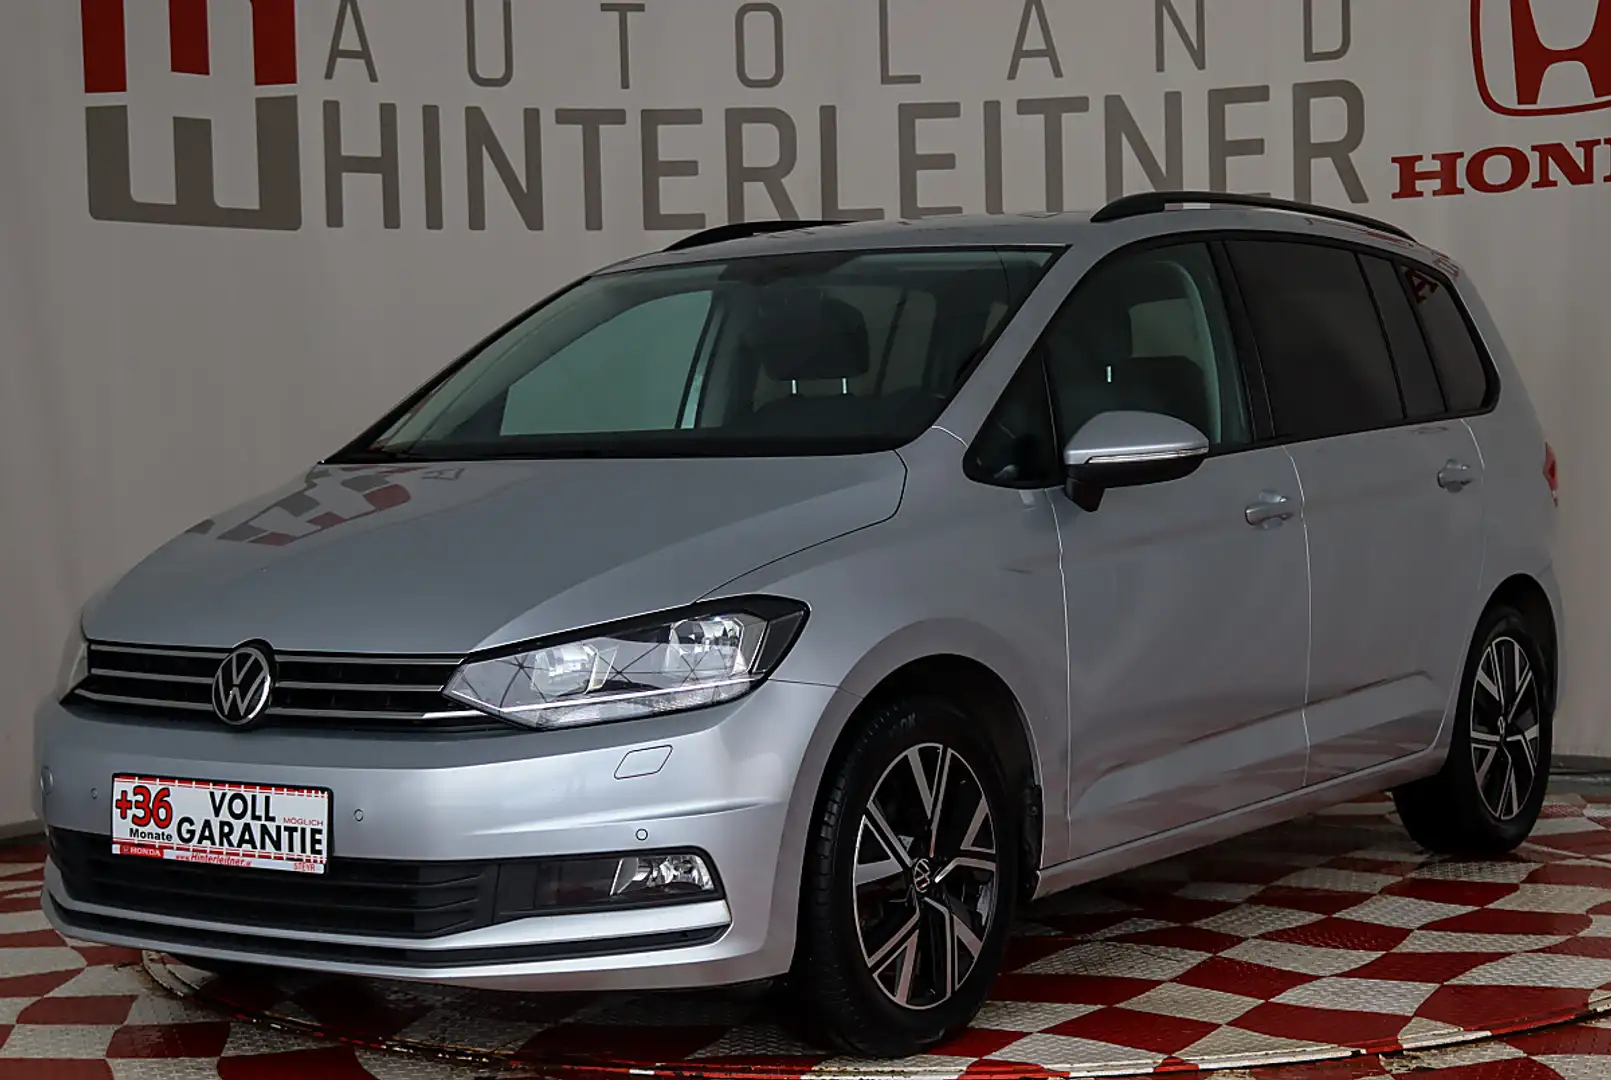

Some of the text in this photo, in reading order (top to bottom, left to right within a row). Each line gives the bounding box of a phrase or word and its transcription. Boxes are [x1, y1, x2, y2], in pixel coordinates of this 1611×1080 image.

[323, 79, 1370, 231] HINTERLEITNER
[115, 785, 173, 829] +36
[209, 791, 276, 822] VOLL
[129, 828, 173, 842] Monate
[130, 847, 161, 857] HONDA
[176, 816, 323, 855] GARANTIE
